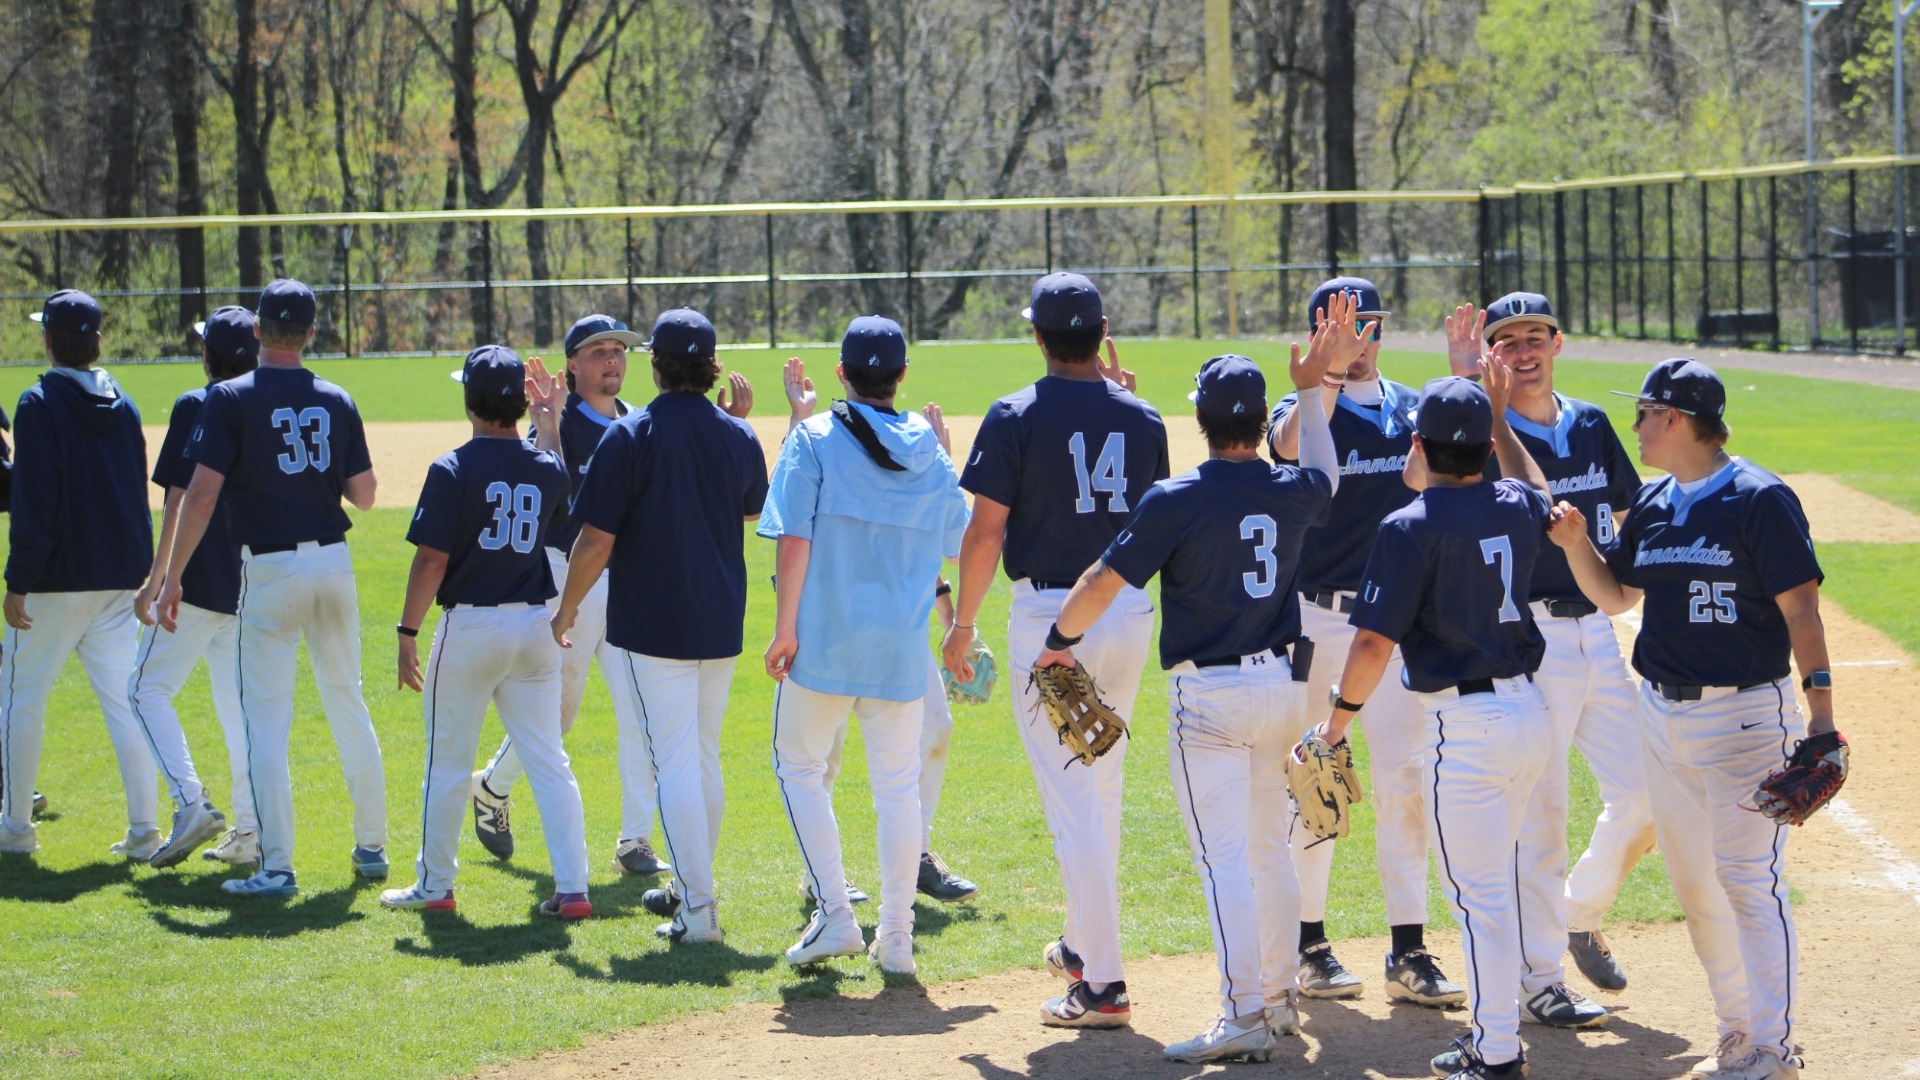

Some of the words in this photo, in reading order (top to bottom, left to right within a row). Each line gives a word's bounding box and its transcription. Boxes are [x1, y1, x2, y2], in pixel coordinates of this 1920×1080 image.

[271, 406, 331, 475] 33
[1068, 431, 1130, 514] 14
[1338, 449, 1408, 476] Immac
[478, 481, 542, 554] 38
[1596, 503, 1614, 545] 8
[1239, 514, 1278, 599] 3
[1479, 534, 1522, 624] 7
[1688, 580, 1738, 624] 25
